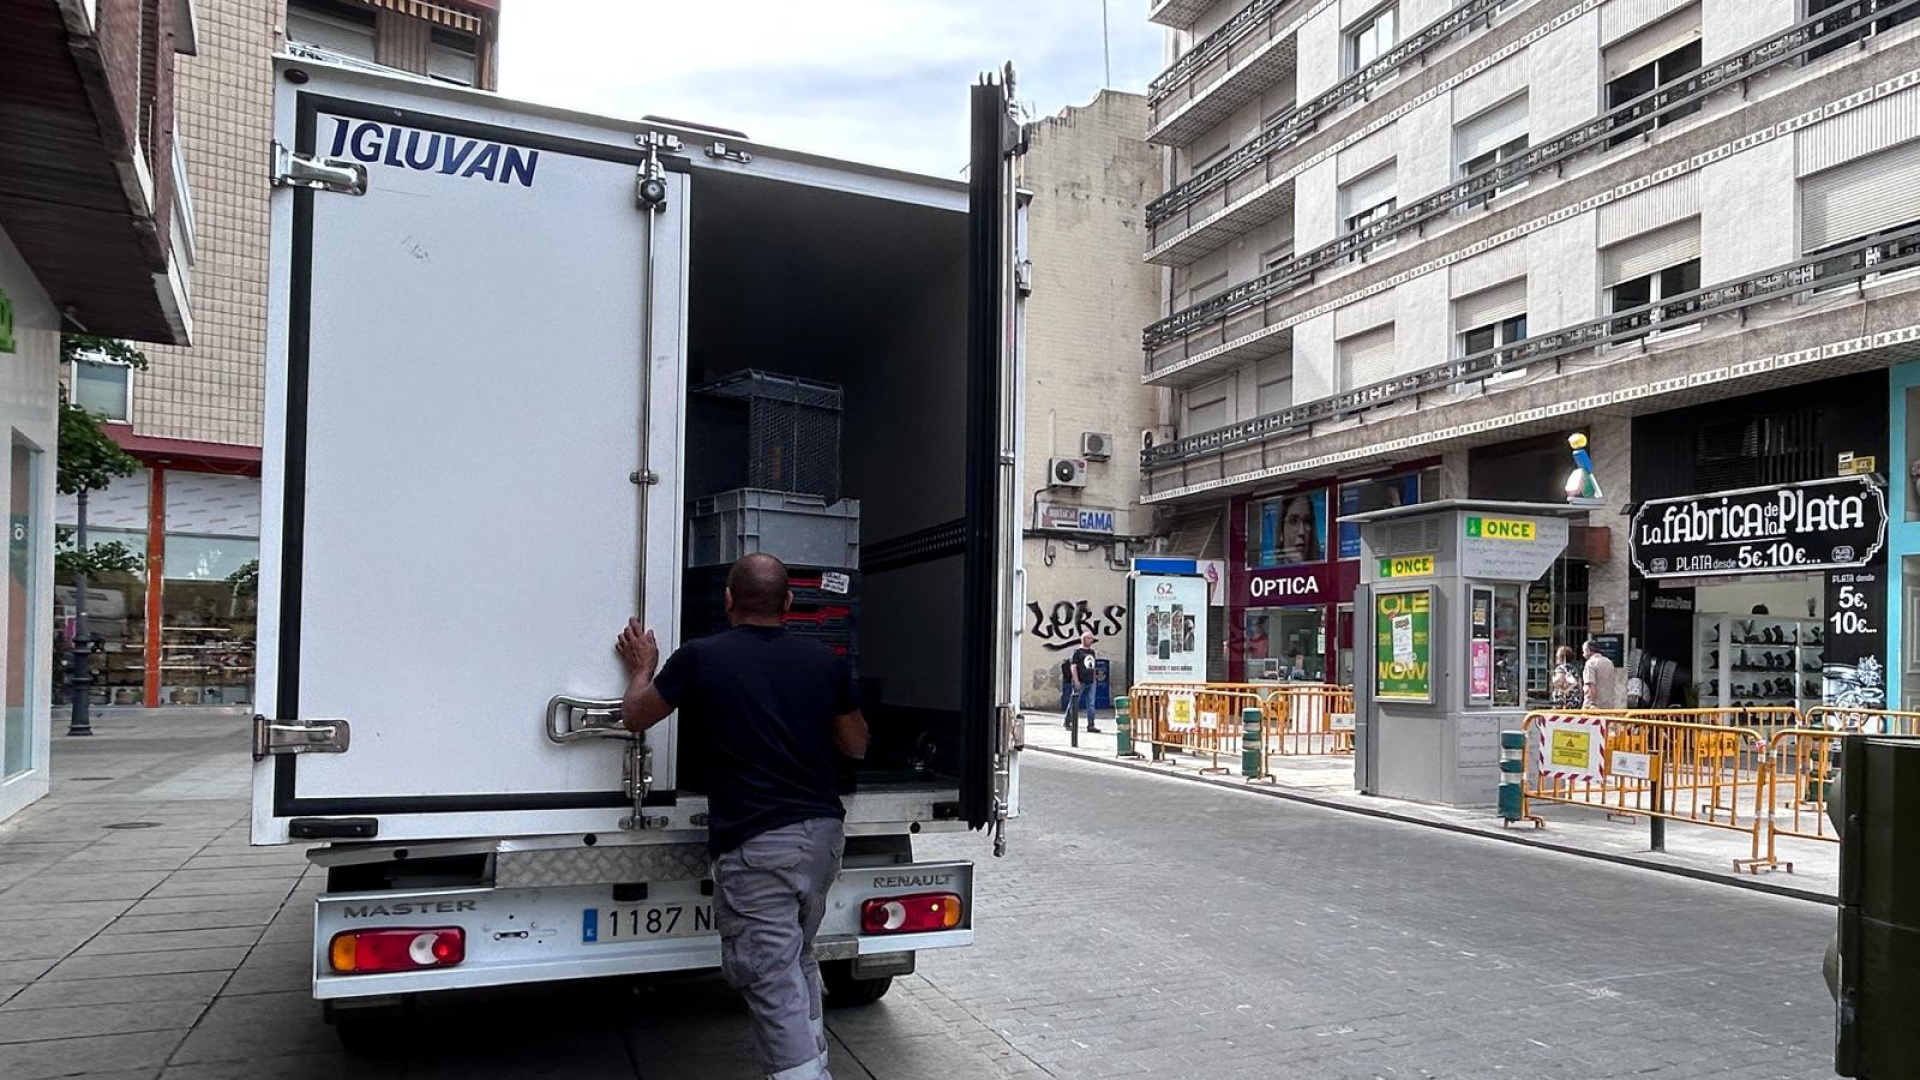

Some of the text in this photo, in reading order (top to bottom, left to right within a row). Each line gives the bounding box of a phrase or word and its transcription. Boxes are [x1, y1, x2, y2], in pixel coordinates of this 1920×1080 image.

[331, 117, 540, 187] IGLUVAN
[1764, 502, 1778, 517] de
[1080, 511, 1113, 531] GAMA
[1487, 521, 1530, 538] ONCE
[1764, 517, 1778, 535] la
[1641, 524, 1661, 545] La
[1395, 557, 1430, 574] ONCE
[1676, 554, 1712, 571] PLATA
[1713, 558, 1736, 569] desde
[1156, 583, 1173, 595] 62
[1250, 576, 1319, 597] OPTICA
[1839, 585, 1867, 610] 5€,
[1379, 661, 1428, 680] NOW
[873, 874, 954, 888] RENAULT
[343, 900, 477, 918] MASTER
[610, 907, 682, 936] 1187
